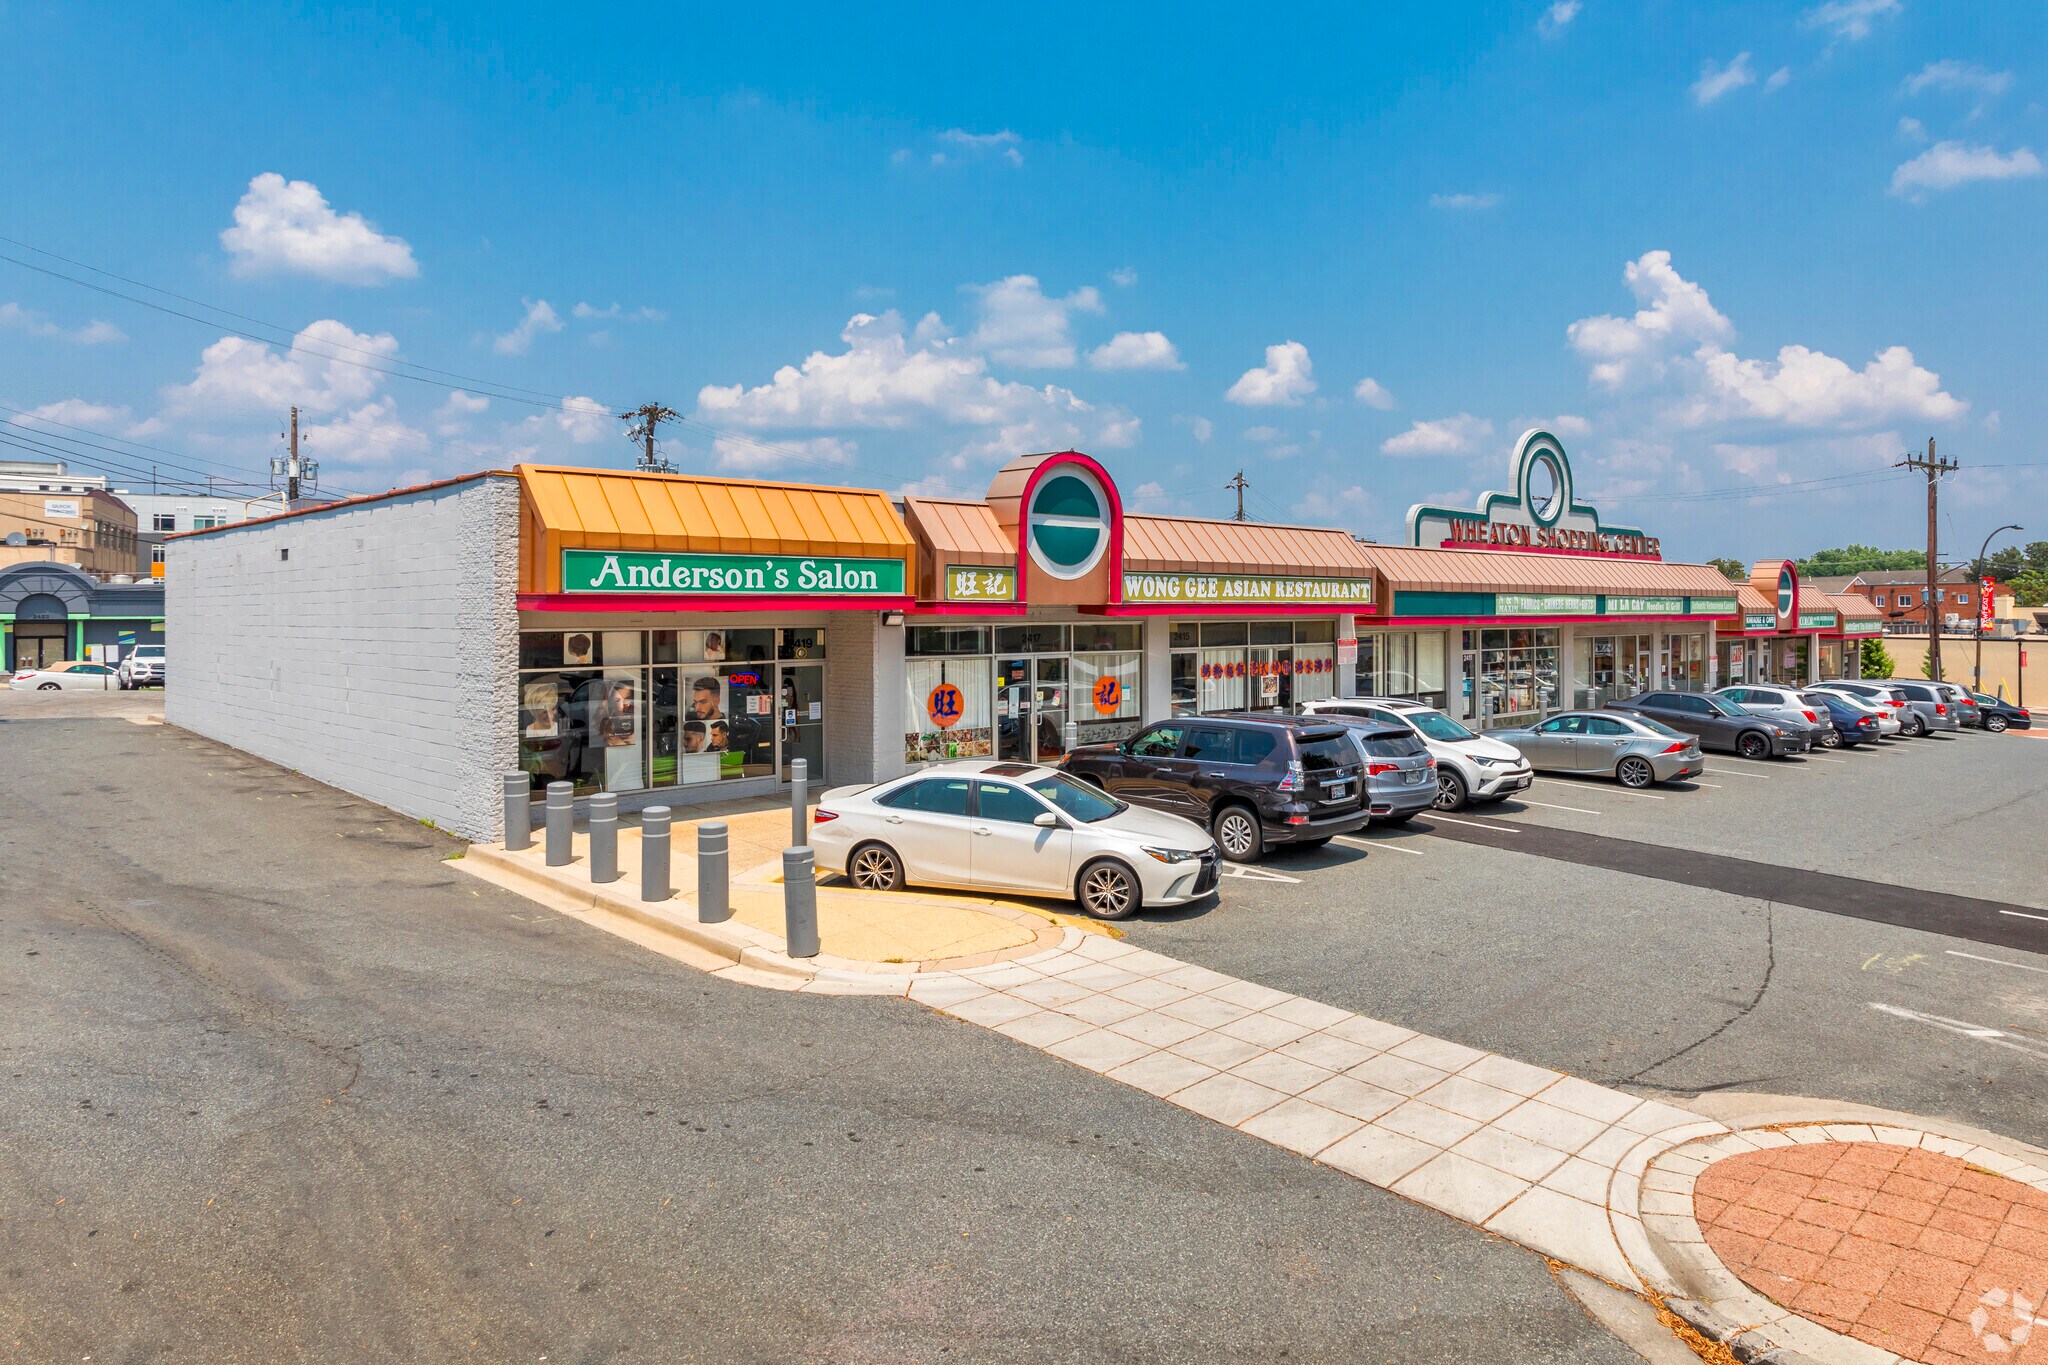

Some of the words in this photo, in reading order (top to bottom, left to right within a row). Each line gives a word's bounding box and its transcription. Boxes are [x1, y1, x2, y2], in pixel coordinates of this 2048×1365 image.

[1450, 518, 1531, 546] WHEATON
[1537, 526, 1610, 553] SHOPPING
[1614, 534, 1661, 556] CENTER
[590, 555, 790, 589] Anderson's
[797, 559, 878, 590] Salon
[954, 571, 1007, 597] 旺記
[1123, 575, 1180, 598] WONG
[1184, 577, 1218, 598] GEE
[1222, 580, 1272, 598] ASIAN
[1275, 581, 1370, 599] RESTAURANT
[1647, 601, 1664, 611] Noodles
[1982, 583, 1991, 619] WHEATON
[1022, 633, 1041, 643] 2417
[1174, 631, 1190, 641] 2415
[729, 673, 757, 685] OPEN
[931, 689, 960, 719] 旺
[1095, 681, 1120, 706] 記
